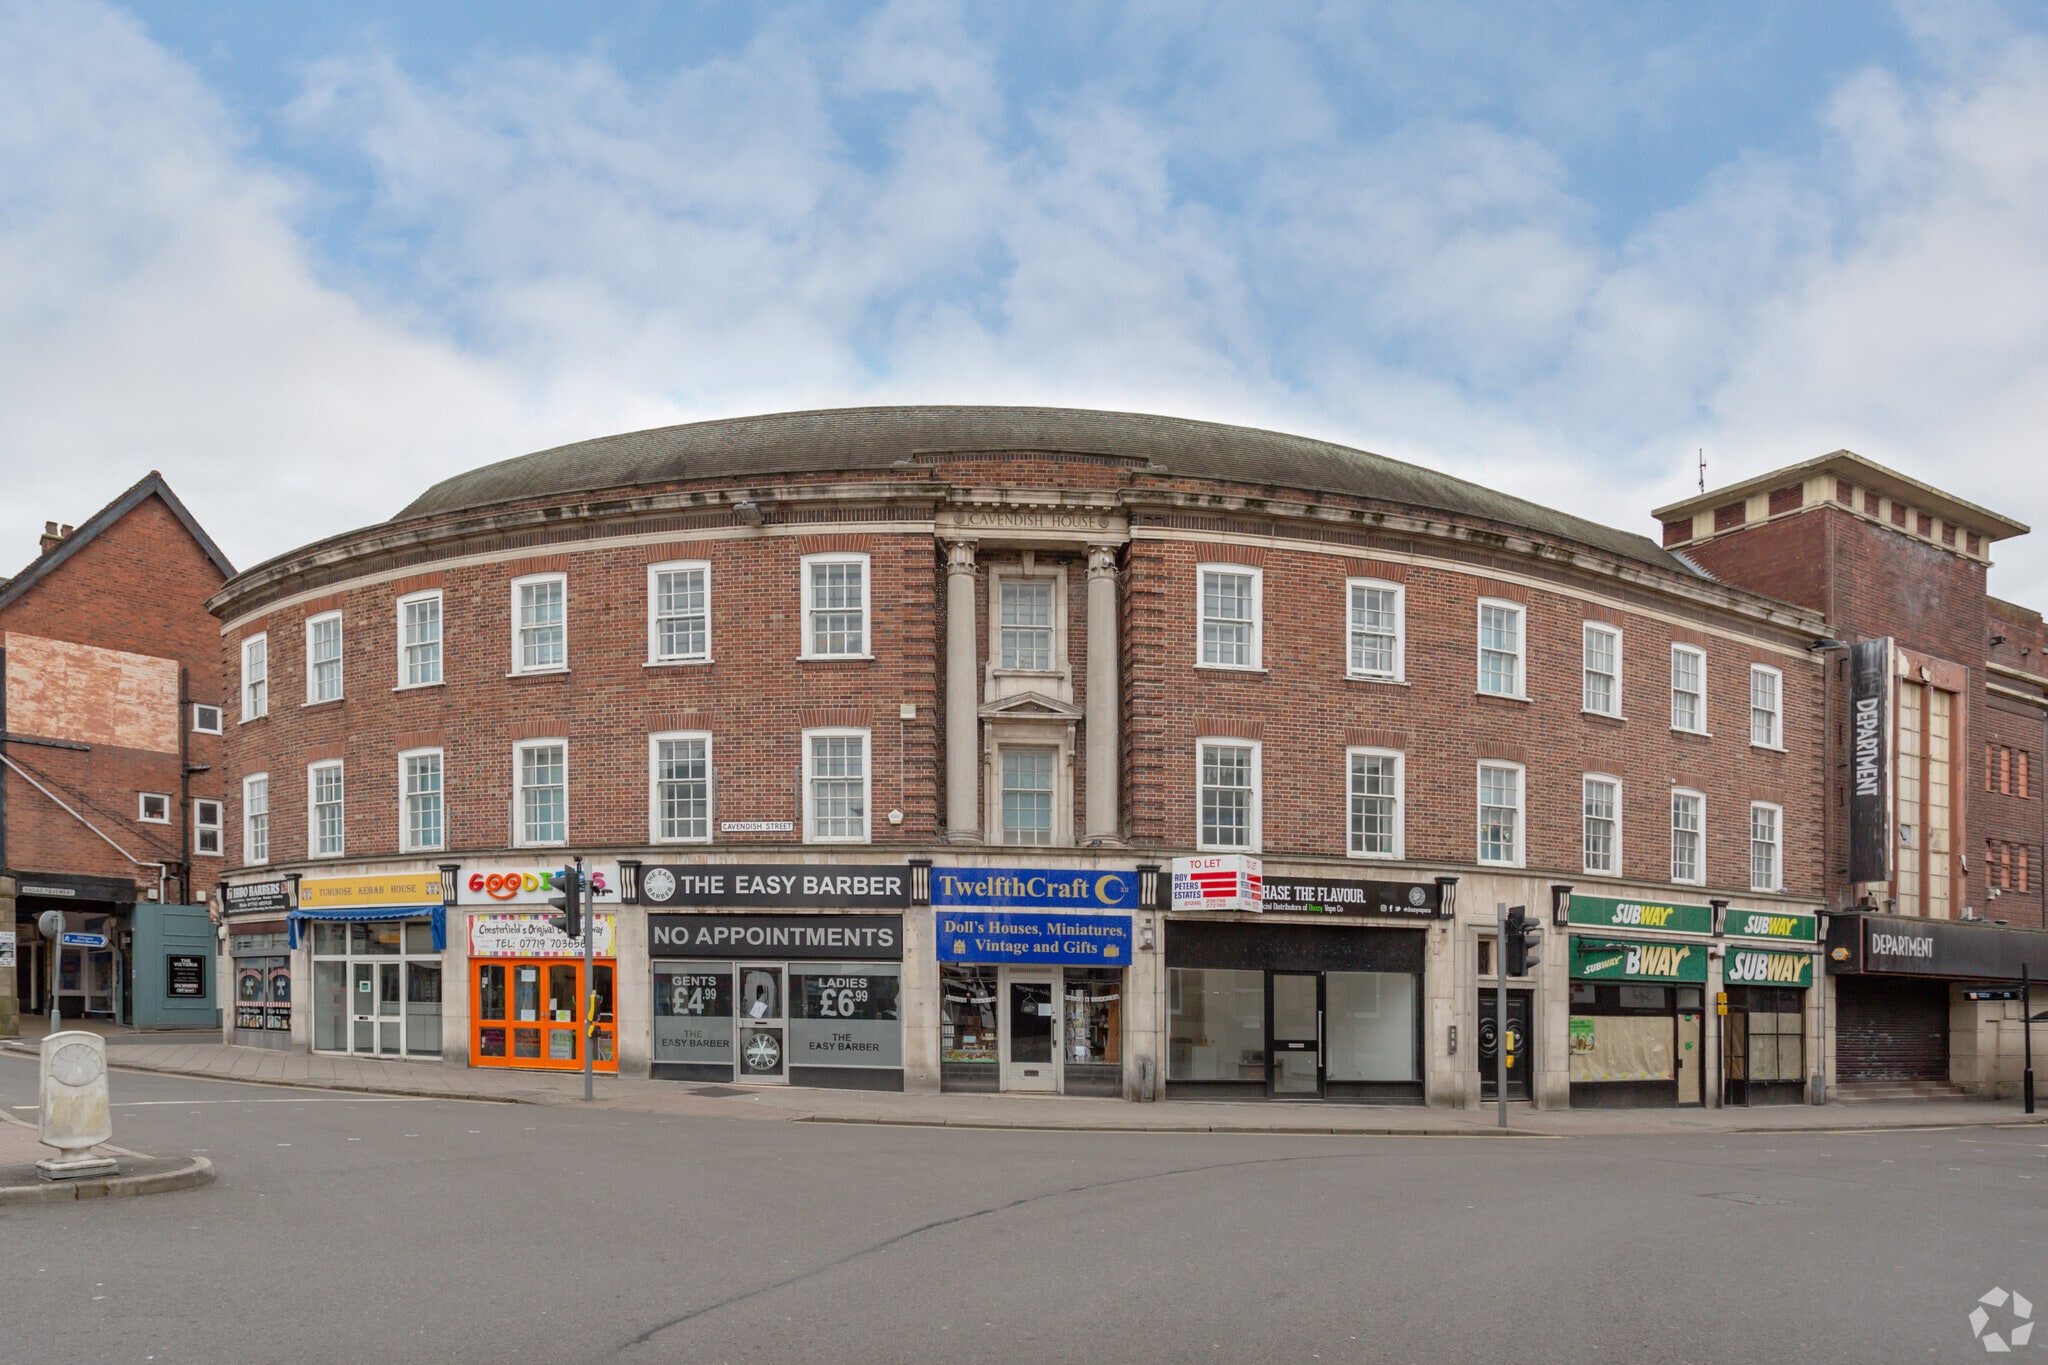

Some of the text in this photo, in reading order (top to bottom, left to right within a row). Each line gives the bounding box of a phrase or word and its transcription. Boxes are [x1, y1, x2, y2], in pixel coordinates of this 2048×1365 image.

[970, 513, 1095, 527] CAVENDISH HOUSE
[1856, 698, 1879, 796] DEPARTMENT
[1189, 859, 1221, 869] TO LET
[1174, 873, 1188, 881] ROY
[248, 883, 280, 897] BARBERS
[358, 886, 384, 895] KEBAB
[391, 884, 416, 893] HOUSE
[681, 875, 902, 895] THE EASY BARBER
[939, 875, 1090, 898] TwelfthCraft
[1174, 881, 1199, 890] PETERS
[1174, 890, 1201, 899] ESTATES
[1262, 886, 1291, 900] HASE
[1294, 887, 1315, 901] THE
[1612, 903, 1674, 926] SUBWAY
[479, 923, 527, 935] Chesterfield's
[528, 924, 555, 937] Original
[944, 920, 1127, 938] Doll's Houses, Miniatures,
[1743, 915, 1798, 936] SUBWAY
[654, 926, 894, 947] NO APPOINTMENTS
[495, 939, 515, 949] TEL:
[519, 939, 546, 949] 07719
[974, 939, 1098, 955] Vintage and Gifts
[1872, 933, 1934, 958] DEPARTMENT
[1583, 955, 1623, 974] SUBWAY
[1605, 943, 1690, 976] BWAY
[1728, 948, 1811, 982] SUBWAY
[672, 976, 717, 986] GENTS
[818, 977, 868, 988] LADIES
[684, 1030, 703, 1038] THE
[832, 1033, 851, 1042] THE
[662, 1038, 730, 1048] EASY BARBER
[809, 1041, 879, 1051] EASY BARBER
